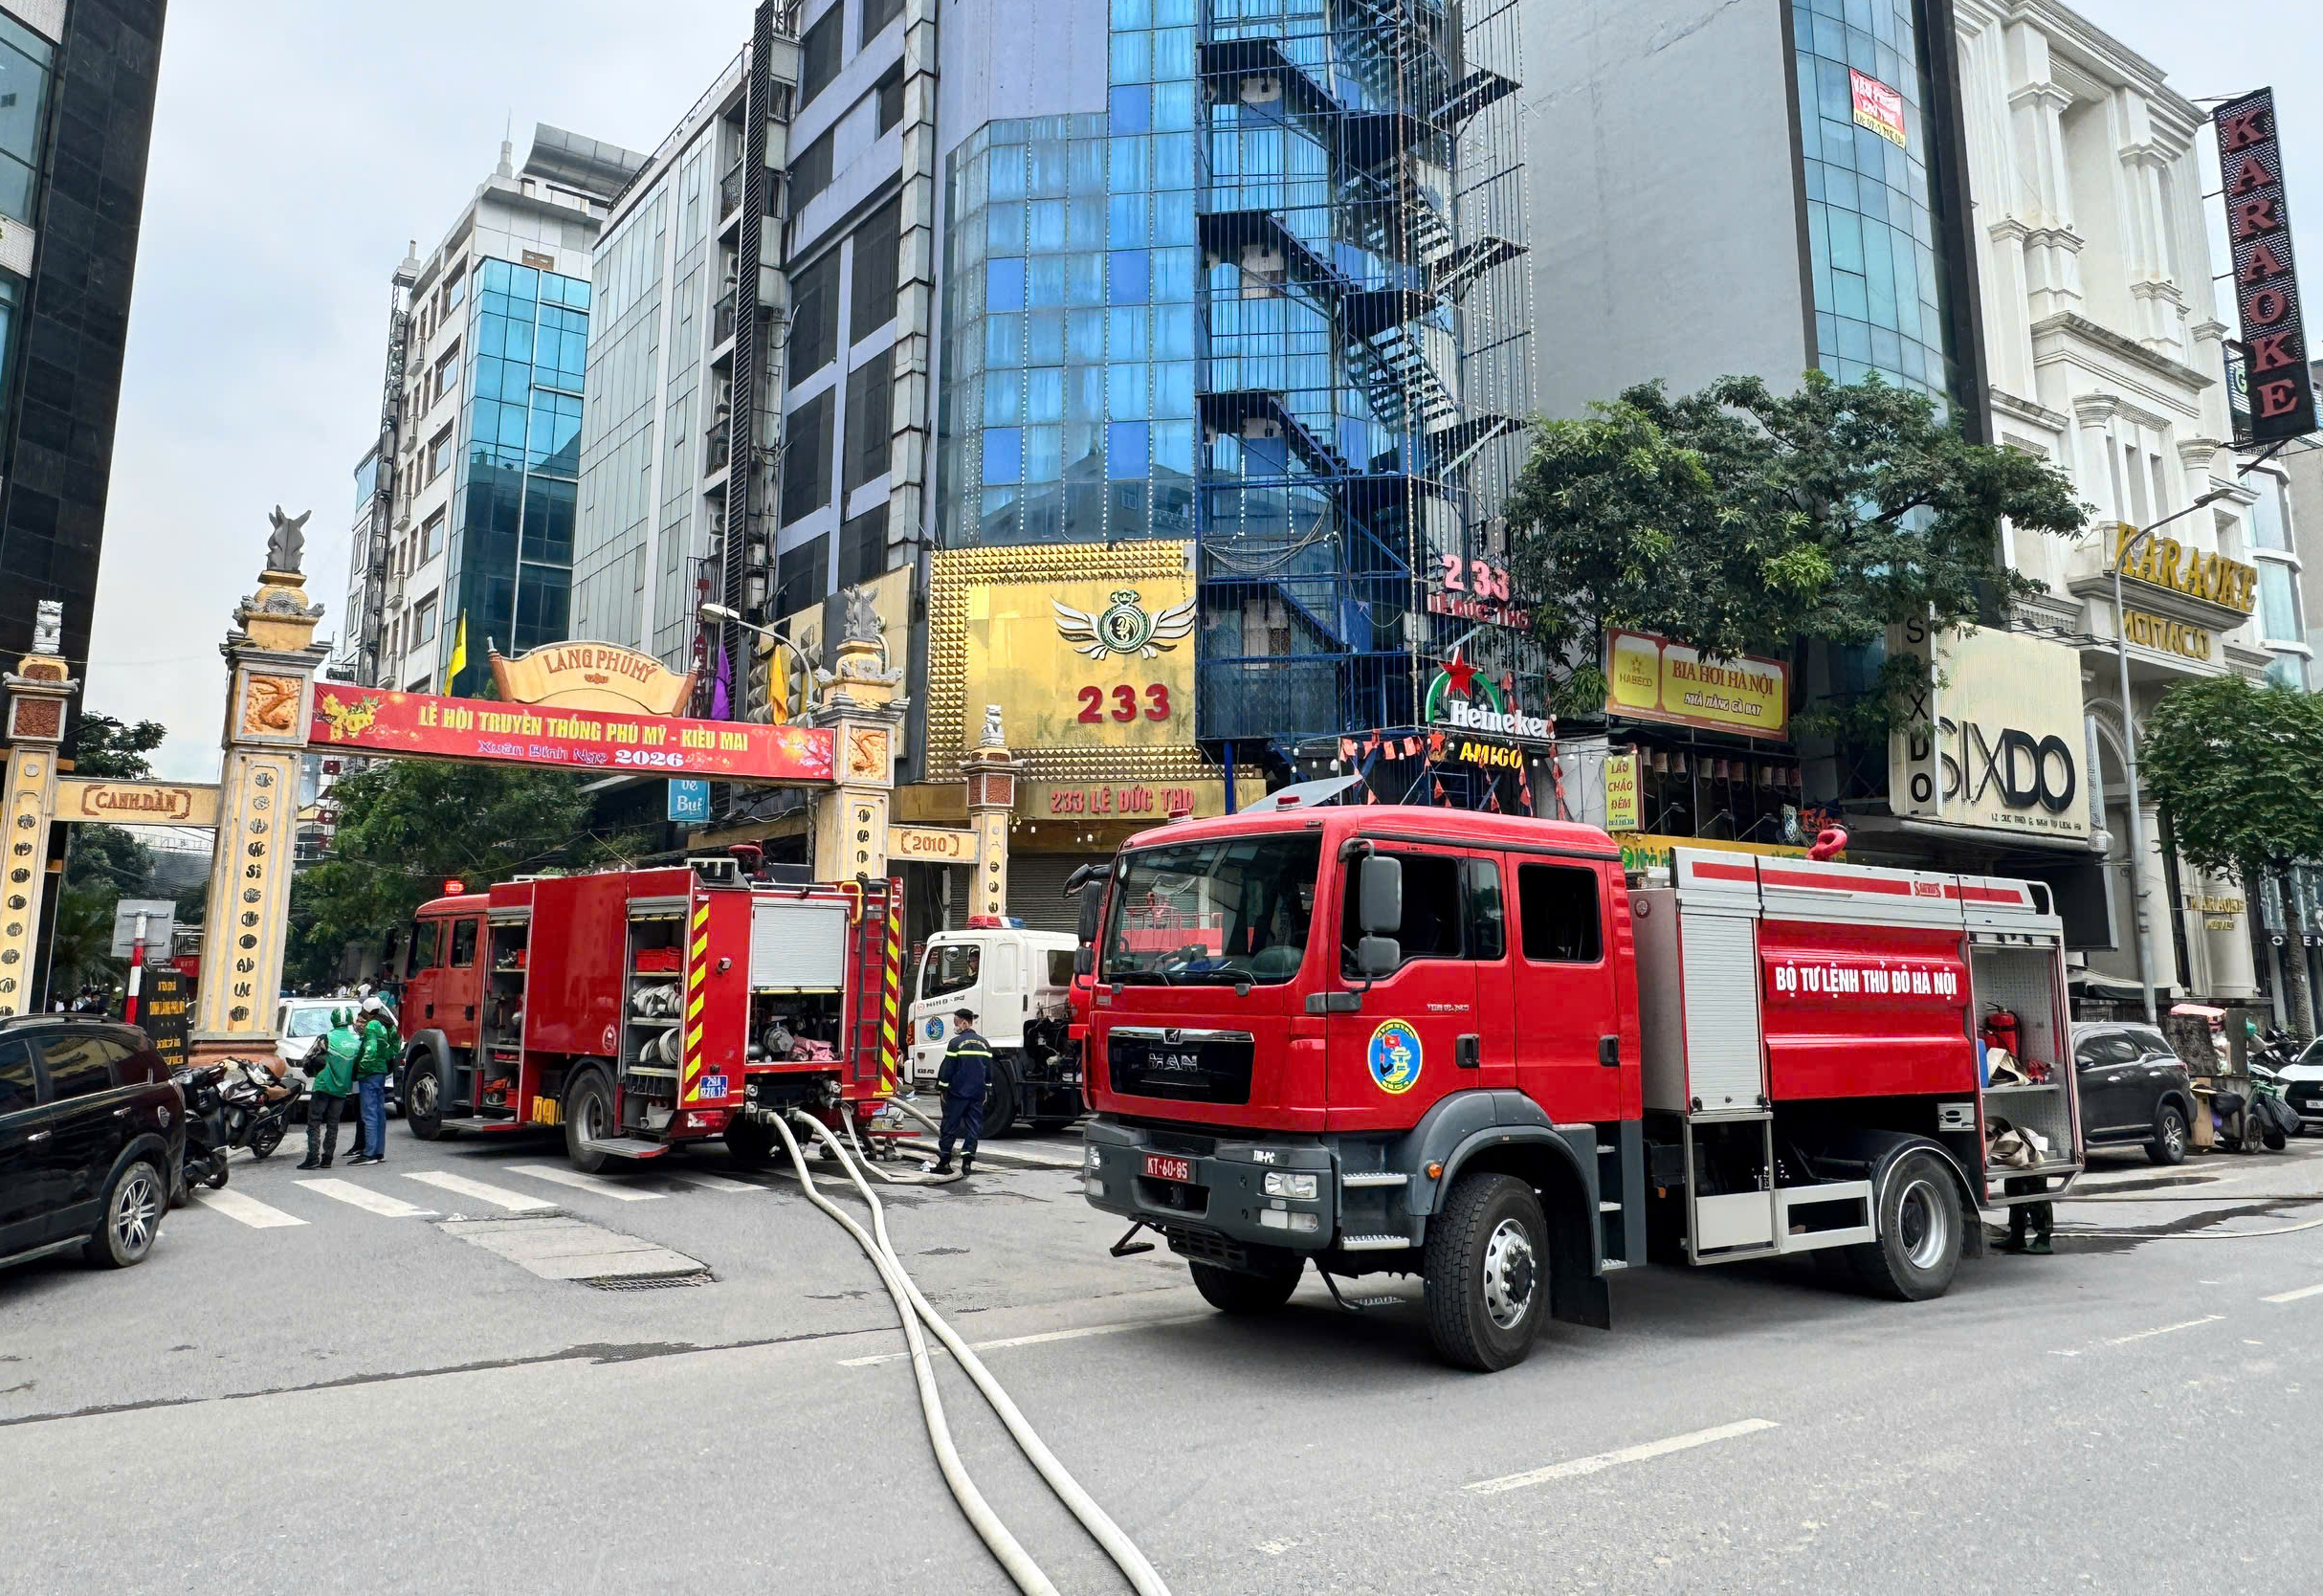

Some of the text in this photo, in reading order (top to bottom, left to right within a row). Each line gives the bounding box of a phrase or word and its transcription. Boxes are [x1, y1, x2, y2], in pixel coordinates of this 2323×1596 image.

[2223, 108, 2298, 418] KARAOKE
[1442, 554, 1510, 602] 233
[2114, 523, 2258, 613] KARAOKE
[1619, 674, 1653, 687] HABECO
[1672, 659, 1696, 681] BIA
[1728, 667, 1748, 690] HÀ
[1749, 673, 1773, 698] NỘI
[1077, 684, 1170, 724] 233
[1906, 617, 1933, 803] SXDO
[418, 700, 437, 727] LỄ
[442, 707, 473, 733] HỘI
[478, 708, 542, 737] TRUYỀN
[546, 715, 601, 743] THỐNG
[607, 721, 638, 744] PHÚ
[680, 724, 716, 750] KIỀU
[720, 732, 748, 752] MAI
[477, 739, 524, 756] Xuân
[615, 749, 685, 767] 2026
[1459, 742, 1523, 768] AMIGO
[1939, 716, 2076, 813] SIXDO
[1051, 790, 1084, 813] 233
[1091, 786, 1112, 813] LÊ
[1118, 785, 1153, 813] ĐỨC
[1607, 777, 1633, 792] CHÁO
[912, 835, 947, 853] 2010
[1775, 959, 1958, 1000] BỘ TƯ LỆNH THỦ ĐÔ HÀ NỘI
[1149, 1053, 1198, 1071] MAN
